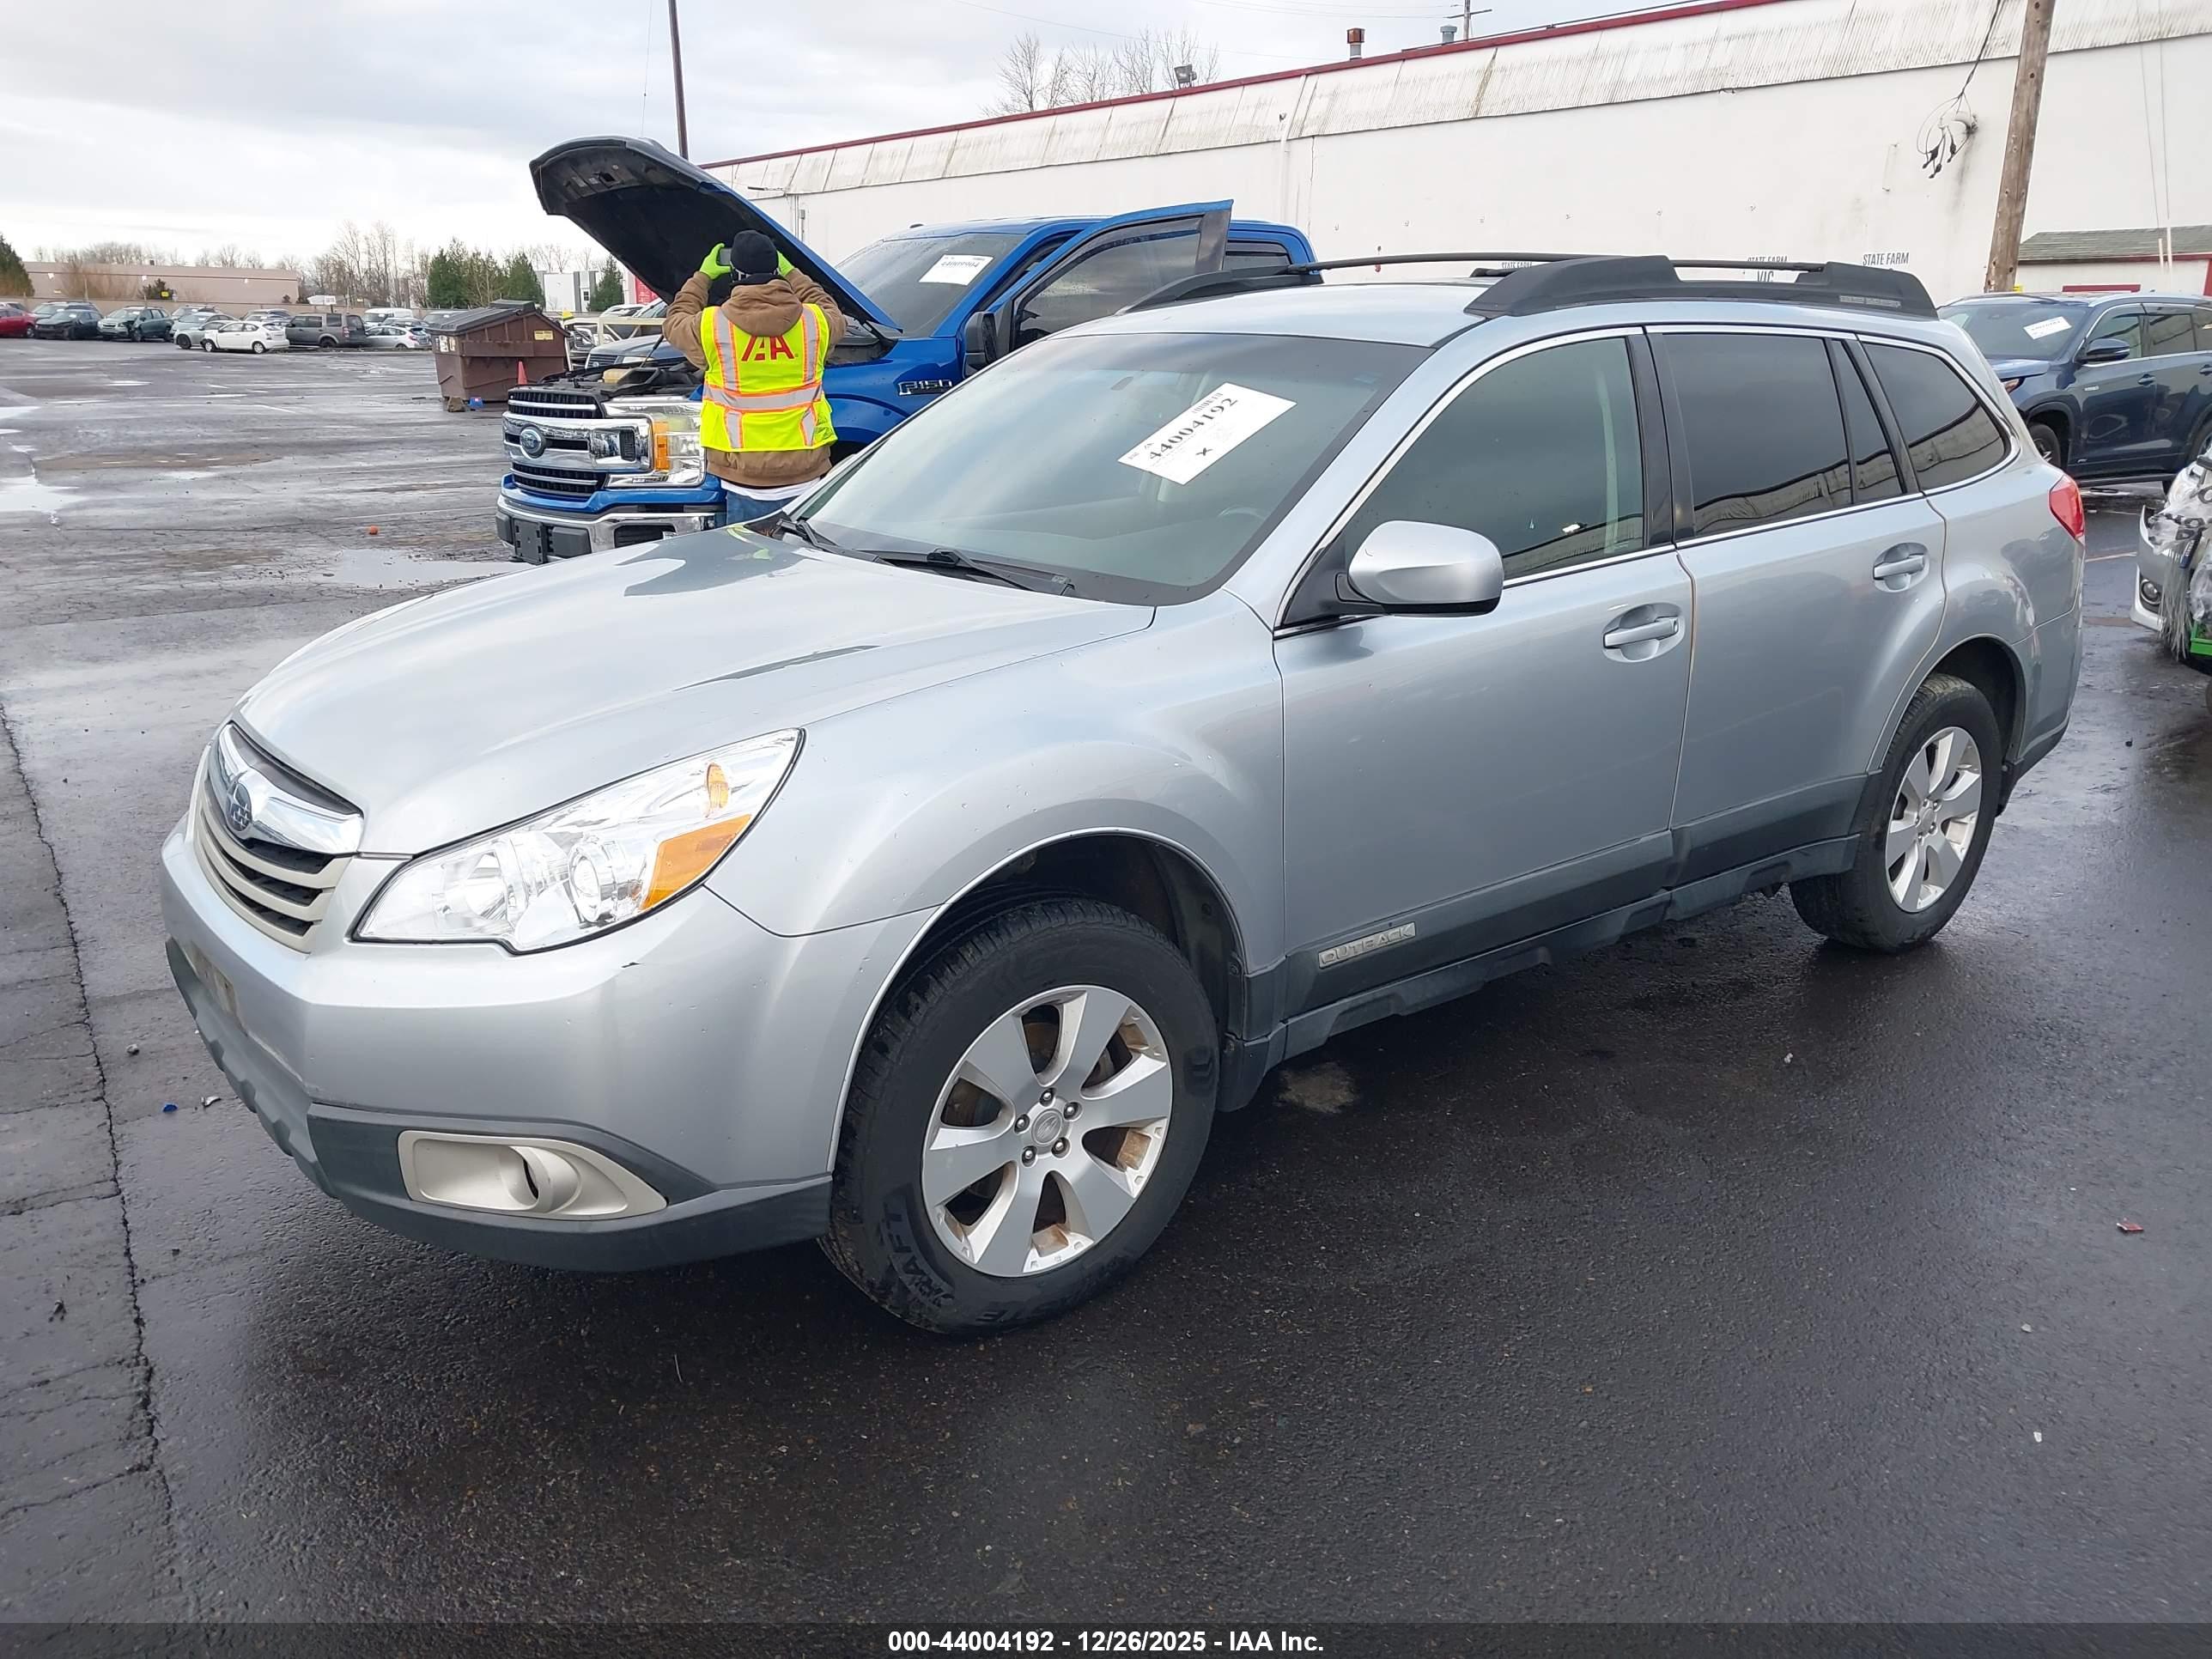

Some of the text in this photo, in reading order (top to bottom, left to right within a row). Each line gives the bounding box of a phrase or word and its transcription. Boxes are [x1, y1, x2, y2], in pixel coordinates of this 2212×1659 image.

[1863, 252, 1910, 266] STATE FARM
[1149, 398, 1238, 459] 44004192
[1321, 923, 1415, 966] OUTBACK
